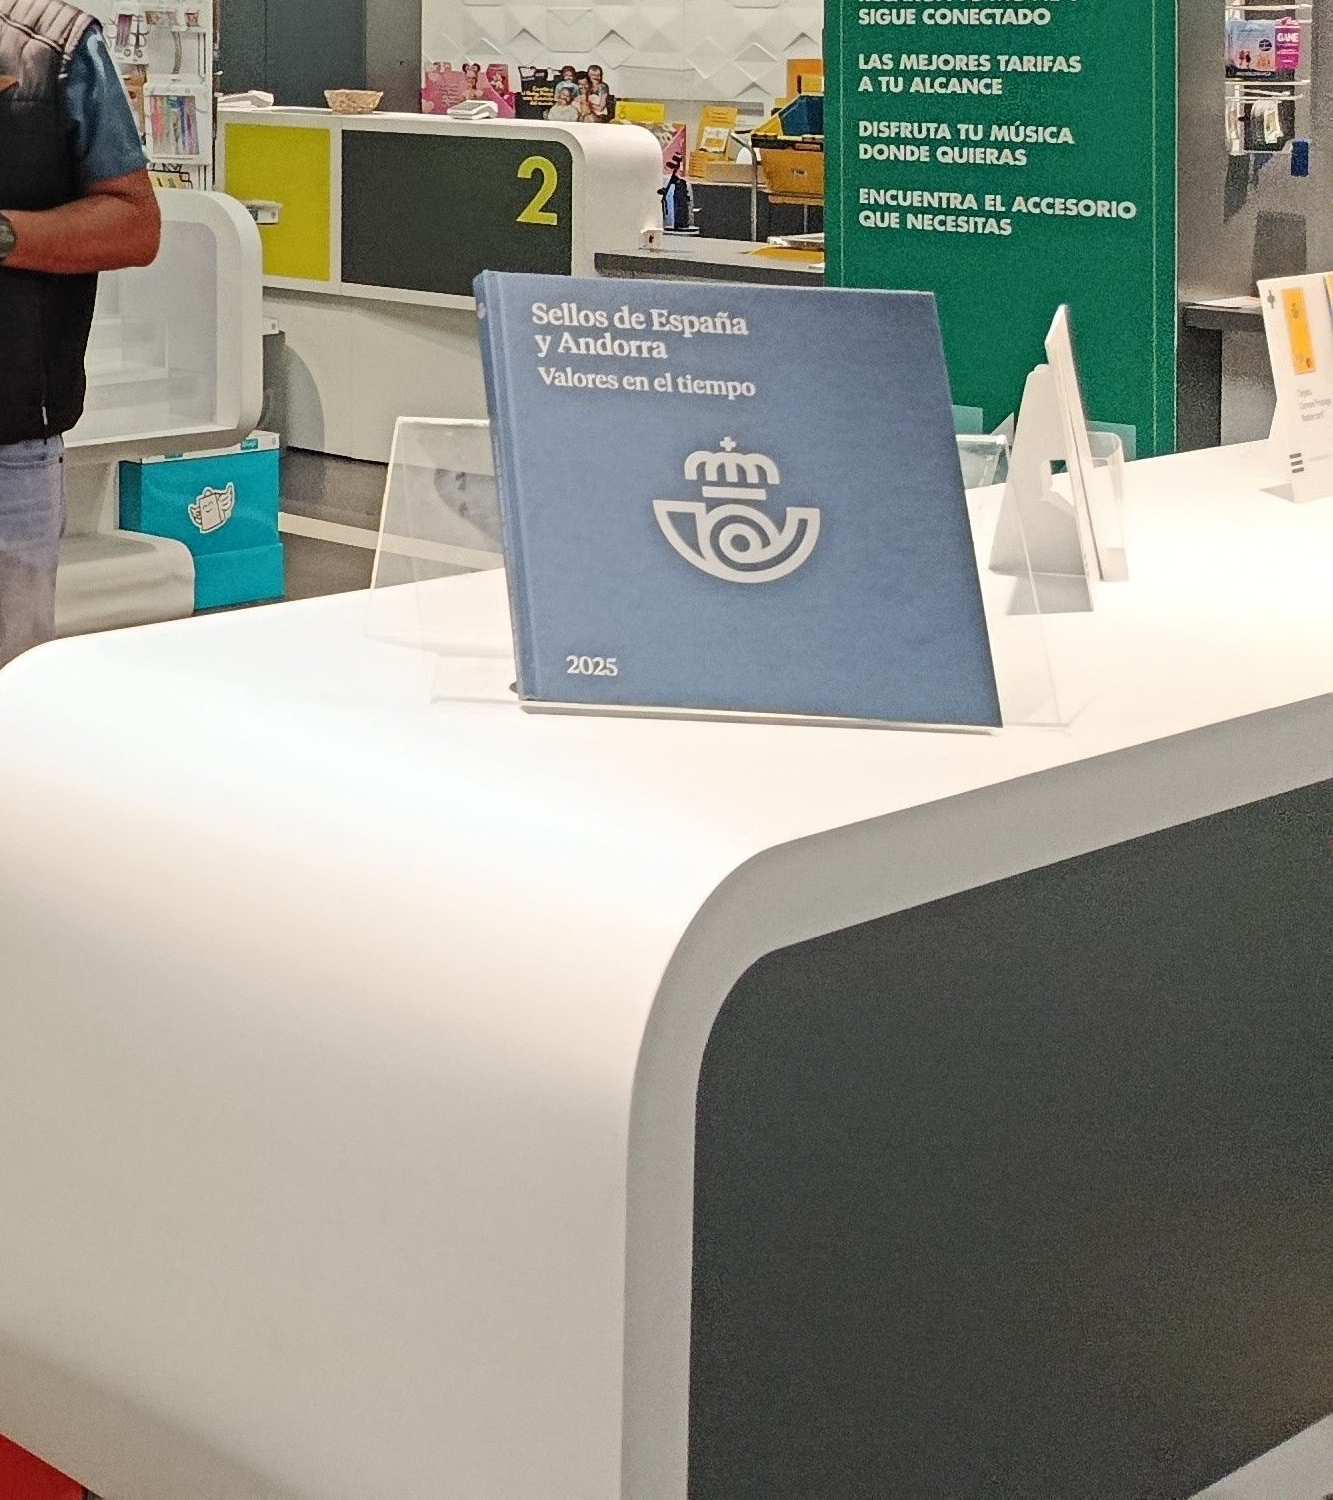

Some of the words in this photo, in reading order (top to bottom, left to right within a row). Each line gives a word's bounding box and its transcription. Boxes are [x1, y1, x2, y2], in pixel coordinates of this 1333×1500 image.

[858, 8, 916, 25] SIGUE
[922, 8, 1051, 25] CONECTADO
[858, 54, 893, 70] LAS
[899, 54, 991, 72] MEJORES
[997, 55, 1082, 73] TARIFAS
[858, 76, 873, 92] A
[879, 76, 904, 93] TU
[910, 77, 1003, 95] ALCANCE
[858, 121, 951, 140] DISFRUTA
[957, 124, 983, 141] TU
[989, 121, 1075, 145] MÚSICA
[858, 144, 930, 162] DONDE
[936, 145, 1028, 166] QUIERAS
[516, 155, 558, 226] 2
[859, 188, 978, 211] ENCUENTRA
[984, 194, 1006, 212] EL
[1011, 196, 1137, 220] ACCESORIO
[858, 210, 900, 230] QUE
[906, 213, 1013, 236] NECESITAS
[531, 302, 607, 329] Sellos
[613, 305, 646, 330] de
[650, 308, 749, 338] España
[534, 335, 551, 358] y
[557, 332, 668, 359] Andorra
[538, 366, 619, 390] Valores
[622, 376, 649, 391] en
[654, 372, 673, 392] el
[676, 374, 756, 400] tiempo
[566, 654, 619, 676] 2025
